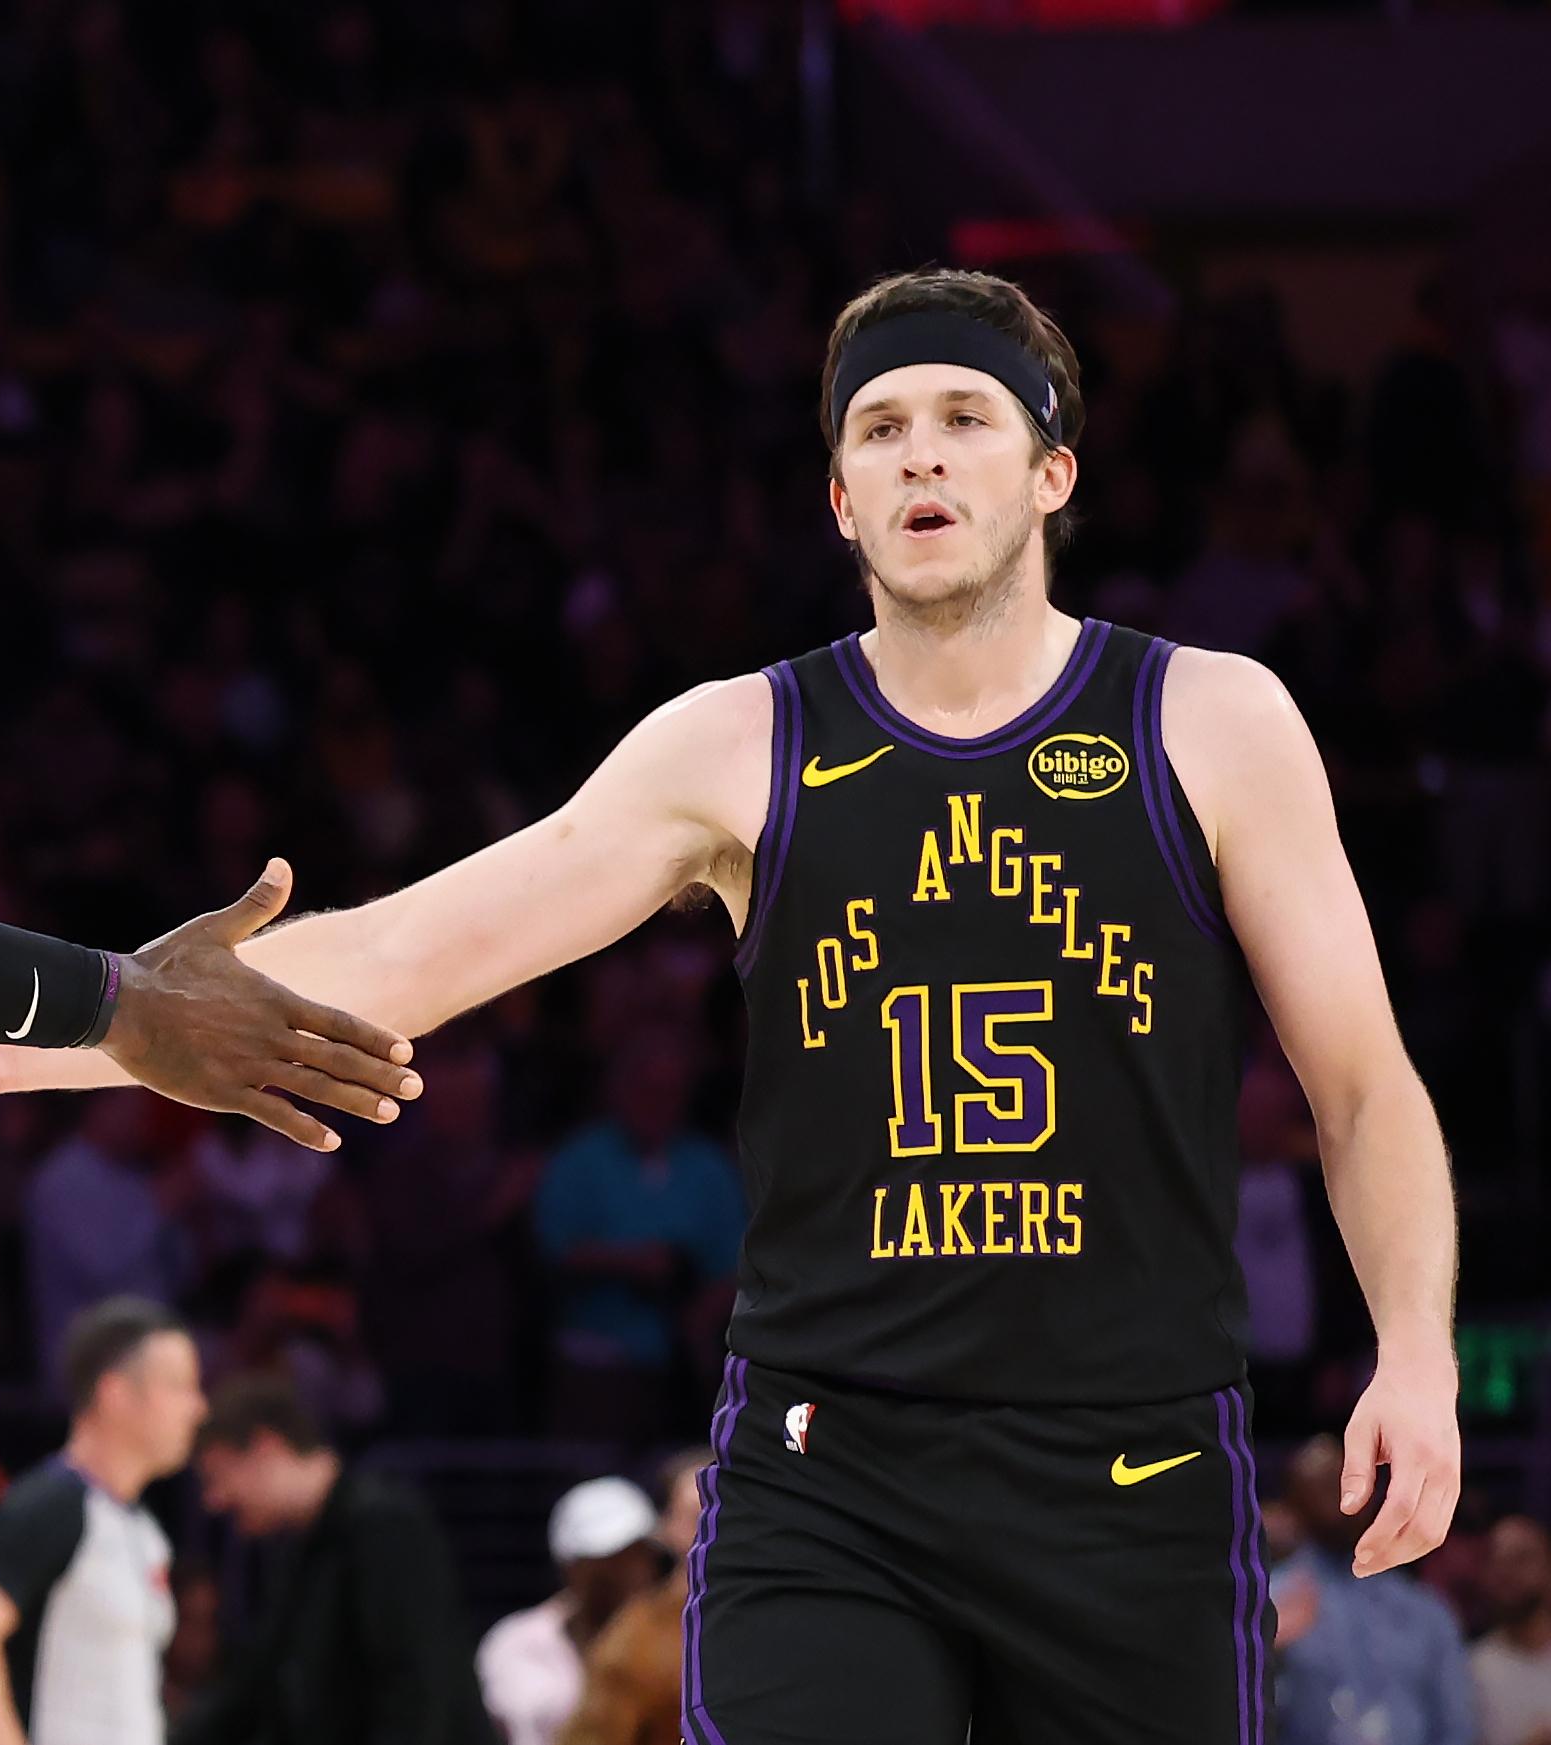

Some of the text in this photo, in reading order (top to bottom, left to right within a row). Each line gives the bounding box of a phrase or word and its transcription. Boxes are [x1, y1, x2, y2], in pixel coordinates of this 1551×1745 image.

[1038, 750, 1123, 780] bibigo
[1053, 772, 1089, 785] 비비고
[797, 793, 1154, 1049] LOS ANGELES
[880, 979, 1056, 1158] 15
[870, 1182, 1084, 1259] LAKERS
